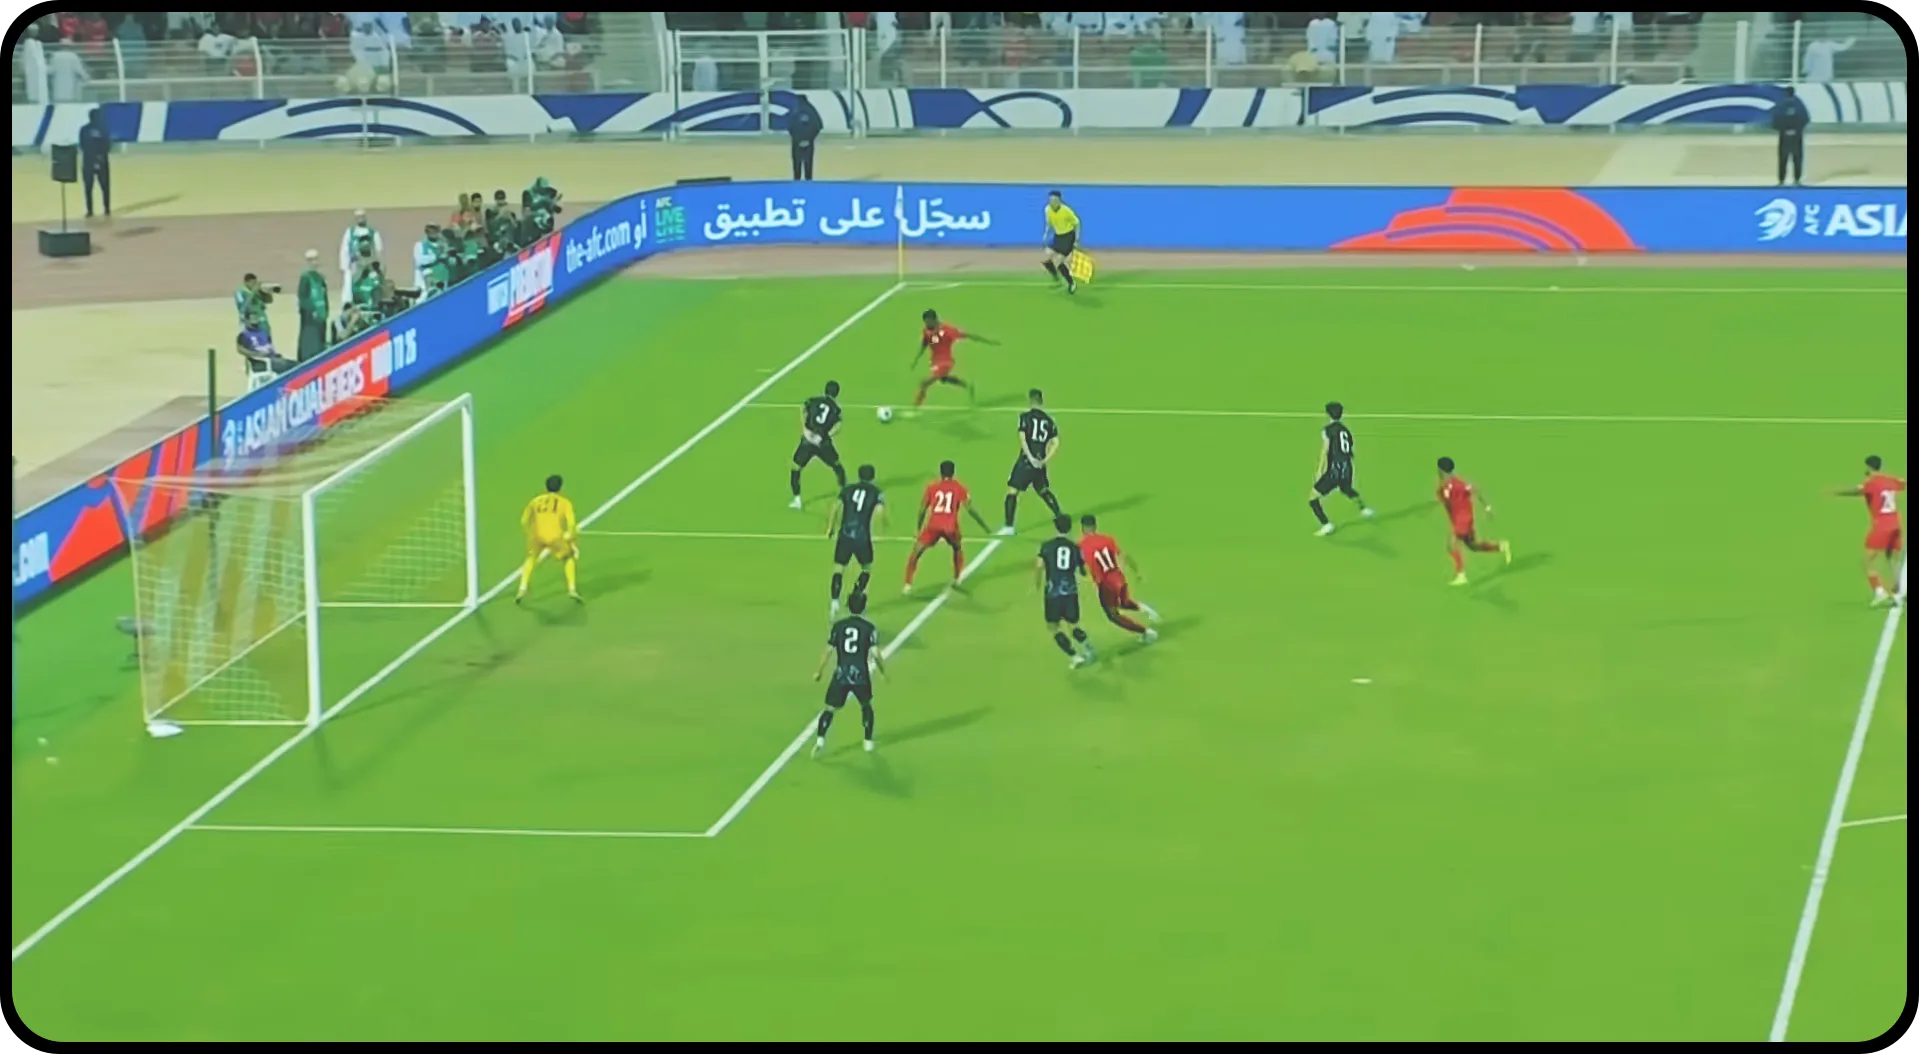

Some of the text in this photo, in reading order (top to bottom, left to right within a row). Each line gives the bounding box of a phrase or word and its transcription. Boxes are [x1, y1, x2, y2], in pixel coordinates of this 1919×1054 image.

[655, 206, 685, 226] LIVE
[703, 197, 806, 240] تطبيق
[819, 197, 885, 236] على
[1804, 204, 1820, 236] AFC
[566, 220, 631, 274] the-afc.com
[243, 396, 287, 453] ASIAN
[815, 403, 830, 424] 3
[1031, 417, 1049, 442] 15
[1339, 430, 1350, 453] 6
[852, 489, 866, 512] 4
[934, 490, 953, 513] 21
[1056, 546, 1071, 570] 8
[1094, 546, 1116, 572] 11
[844, 627, 859, 653] 2
